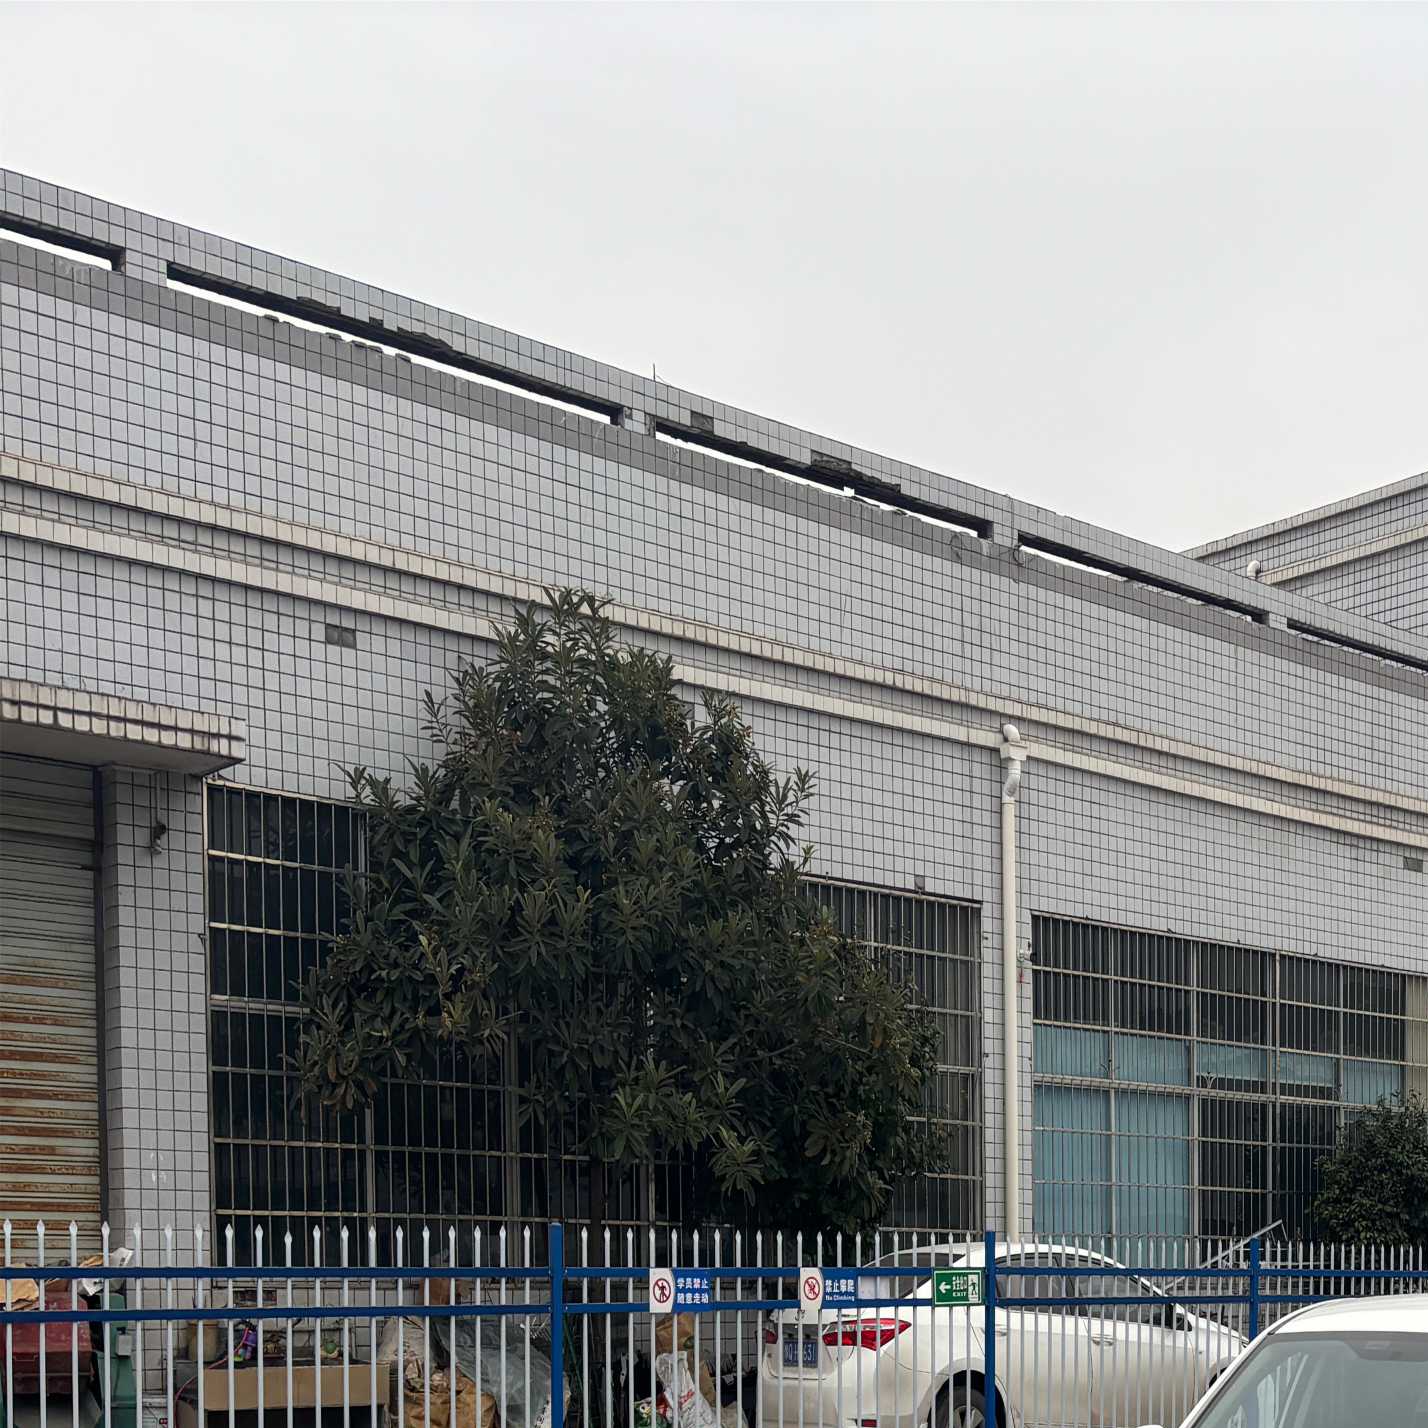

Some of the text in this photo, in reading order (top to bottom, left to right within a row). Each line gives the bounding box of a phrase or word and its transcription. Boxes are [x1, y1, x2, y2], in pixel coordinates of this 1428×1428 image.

[676, 1277, 709, 1290] 学员禁止
[825, 1279, 855, 1293] 禁止攀爬
[676, 1292, 709, 1304] 随意走动
